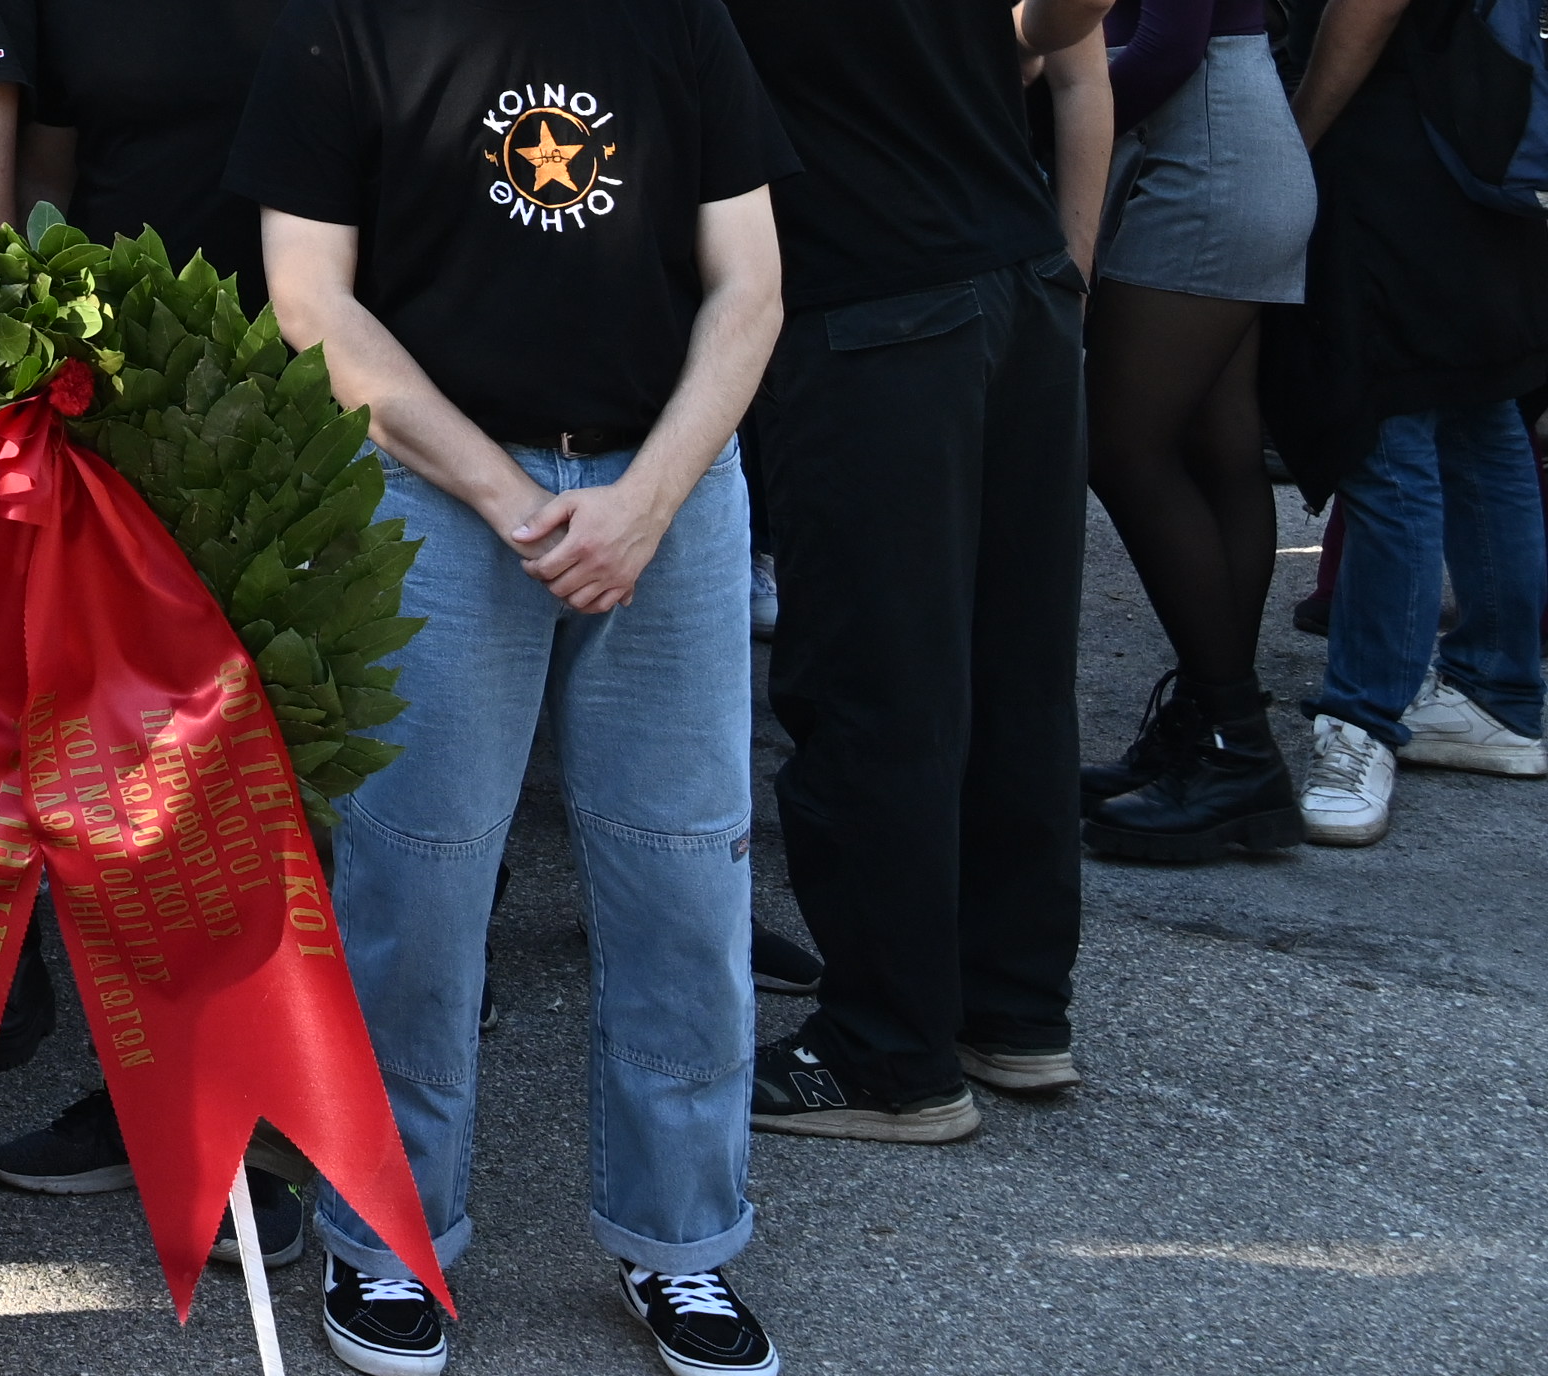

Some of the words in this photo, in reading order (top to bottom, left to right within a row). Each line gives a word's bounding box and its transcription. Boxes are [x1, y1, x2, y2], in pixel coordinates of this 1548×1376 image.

[483, 83, 613, 135] ΚΟΙΝΟΙ
[490, 176, 623, 232] ΘΝΗΤΟΙ
[58, 715, 171, 986] ΚΟΙΝΩΝΙΟΛΟΓΙΑΣ
[108, 740, 197, 934] ΓΕΩΛΟΓΙΚΟΥ
[139, 708, 243, 941] ΠΛΗΡΟΦΟΡΙΚΗΣ
[185, 740, 272, 894] ΣΥΛΛΟΓΟΙ
[211, 660, 336, 959] ΦΟΙΤΗΤΙΚΟΙ
[61, 883, 155, 1070] ΝΗΠΙΑΓΩΓΩΝ
